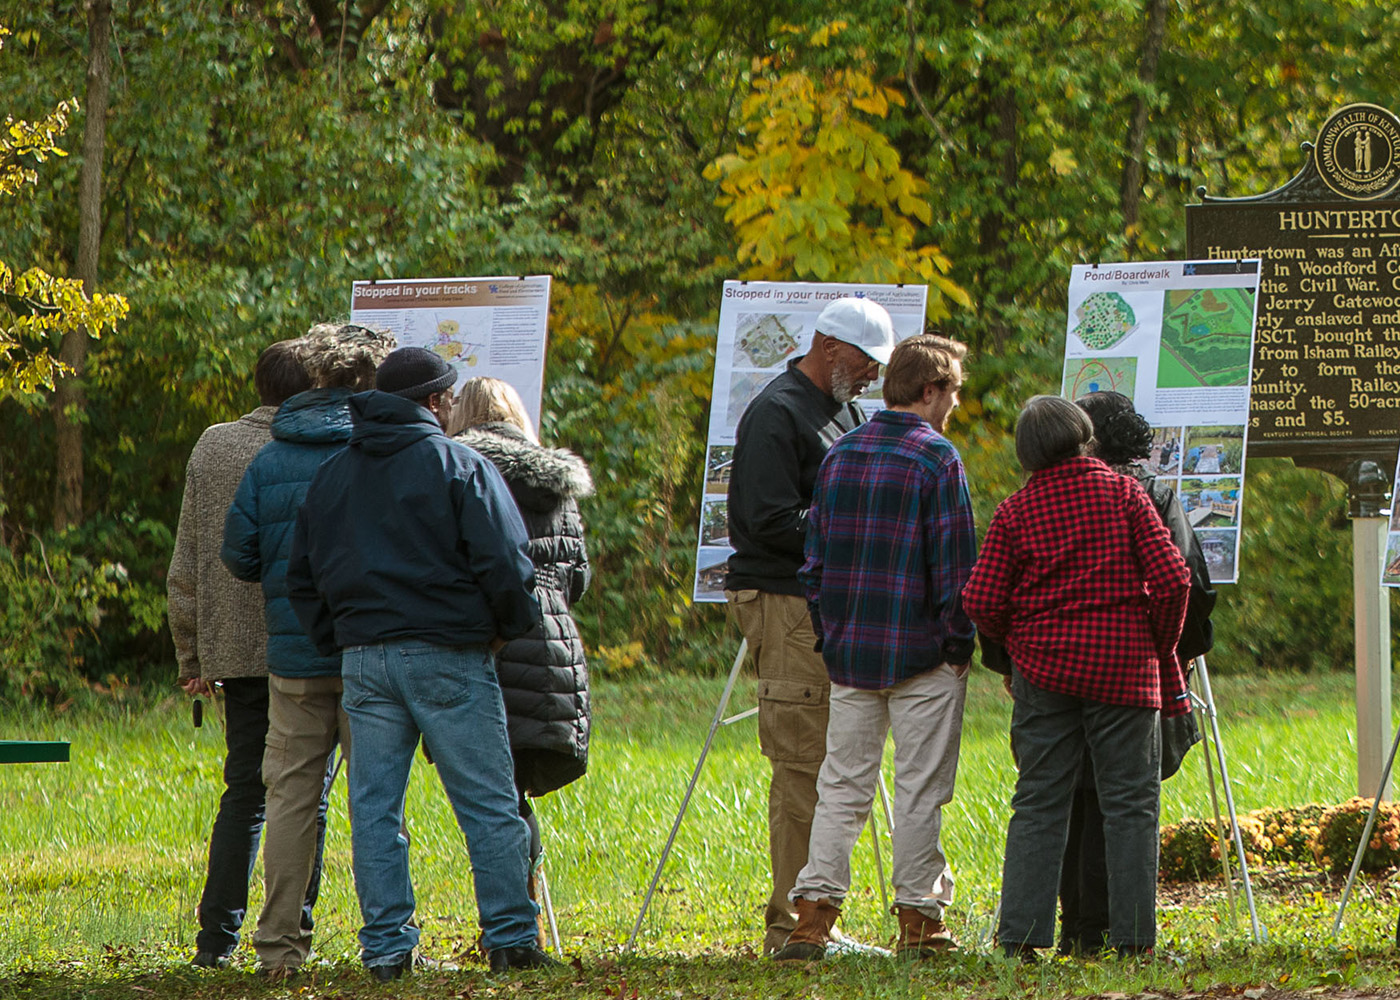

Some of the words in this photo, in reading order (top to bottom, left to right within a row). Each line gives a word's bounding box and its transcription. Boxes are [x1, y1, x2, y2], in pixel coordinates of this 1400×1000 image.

[1322, 112, 1366, 173] COMMONWEALTH
[1367, 112, 1380, 123] OF
[1207, 245, 1306, 260] Huntertown
[1316, 248, 1344, 258] was
[1351, 247, 1372, 258] an
[1084, 269, 1171, 281] Pond/Boardwalk
[1274, 263, 1290, 276] in
[1298, 260, 1377, 276] Woodford
[354, 286, 400, 299] Stopped
[402, 285, 413, 296] in
[415, 286, 442, 298] your
[443, 284, 478, 295] tracks
[1260, 279, 1288, 293] the
[1300, 277, 1337, 292] Civil
[1345, 276, 1380, 292] War.
[724, 288, 771, 300] Stopped
[773, 289, 784, 299] in
[786, 290, 812, 301] your
[815, 290, 849, 300] tracks
[1265, 295, 1315, 311] Jerry
[1295, 310, 1363, 326] enslaved
[1314, 327, 1373, 345] bought
[1259, 346, 1299, 360] from
[1304, 344, 1350, 359] Isham
[1280, 364, 1298, 377] to
[1317, 361, 1357, 376] form
[1309, 395, 1336, 410] the
[1275, 412, 1306, 427] and
[1322, 410, 1351, 426] $5.
